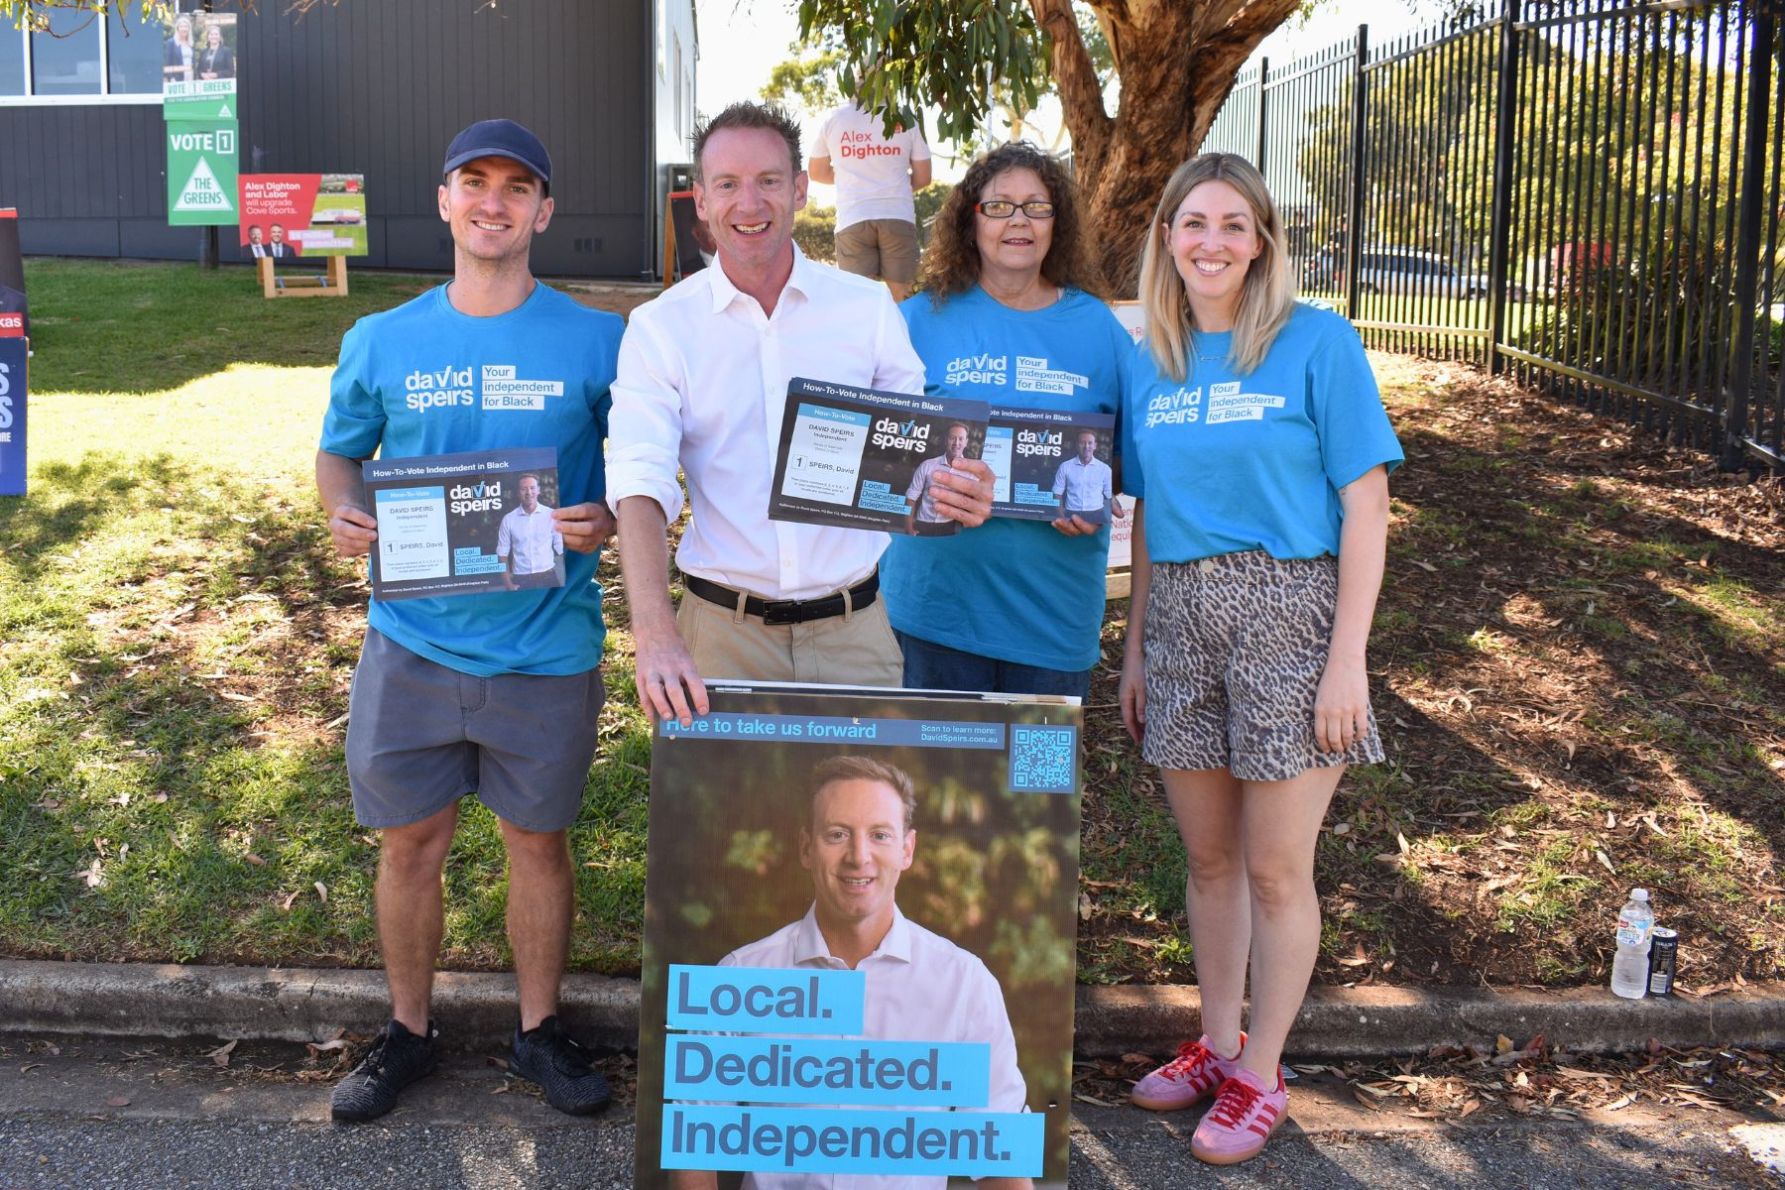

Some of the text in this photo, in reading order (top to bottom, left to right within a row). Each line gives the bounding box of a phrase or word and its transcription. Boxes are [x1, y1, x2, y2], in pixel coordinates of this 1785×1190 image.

[171, 134, 213, 151] VOTE
[841, 131, 872, 143] Alex
[841, 144, 901, 159] Dighton
[194, 178, 211, 189] THE
[245, 182, 301, 192] Alex Dighton
[184, 192, 221, 204] GREENS
[260, 199, 292, 208] upgrade
[268, 207, 298, 215] Sports.
[946, 353, 1007, 372] david
[1019, 358, 1042, 367] Your
[405, 365, 473, 391] david
[484, 367, 510, 377] Your
[1018, 370, 1081, 384] independent
[944, 371, 1007, 386] speirs
[484, 381, 554, 393] independent
[1018, 380, 1064, 391] for Black
[1212, 385, 1235, 394] Your
[406, 389, 473, 413] speirs
[484, 396, 534, 407] for Black
[803, 382, 943, 412] How-To-Vote Independent in Black
[1149, 386, 1201, 411] david
[1211, 396, 1276, 407] independent
[1001, 410, 1044, 419] Independent
[1145, 408, 1199, 428] speirs
[1208, 410, 1253, 421] for Black
[831, 428, 854, 437] SPEIRS
[876, 418, 930, 439] david
[814, 432, 847, 442] Independent
[872, 432, 926, 453] speirs
[1018, 429, 1062, 445] david
[1016, 443, 1061, 457] speirs
[796, 457, 802, 467] 1
[809, 461, 854, 474] SPEIRS, David
[373, 467, 424, 477] How-To-Vote
[426, 463, 476, 473] Independent
[486, 461, 509, 469] Black
[450, 481, 501, 499] david
[450, 498, 502, 516] speirs
[387, 543, 393, 552] 1
[456, 565, 502, 574] Independent.
[714, 720, 732, 733] to
[736, 720, 776, 734] take
[781, 724, 802, 736] us
[807, 722, 876, 739] forward
[921, 724, 940, 732] Scan
[921, 734, 998, 743] DavidSpeirs.com.au
[677, 971, 832, 1018] Local.
[675, 1042, 952, 1091] Dedicated.
[671, 1111, 1011, 1166] Independent.
